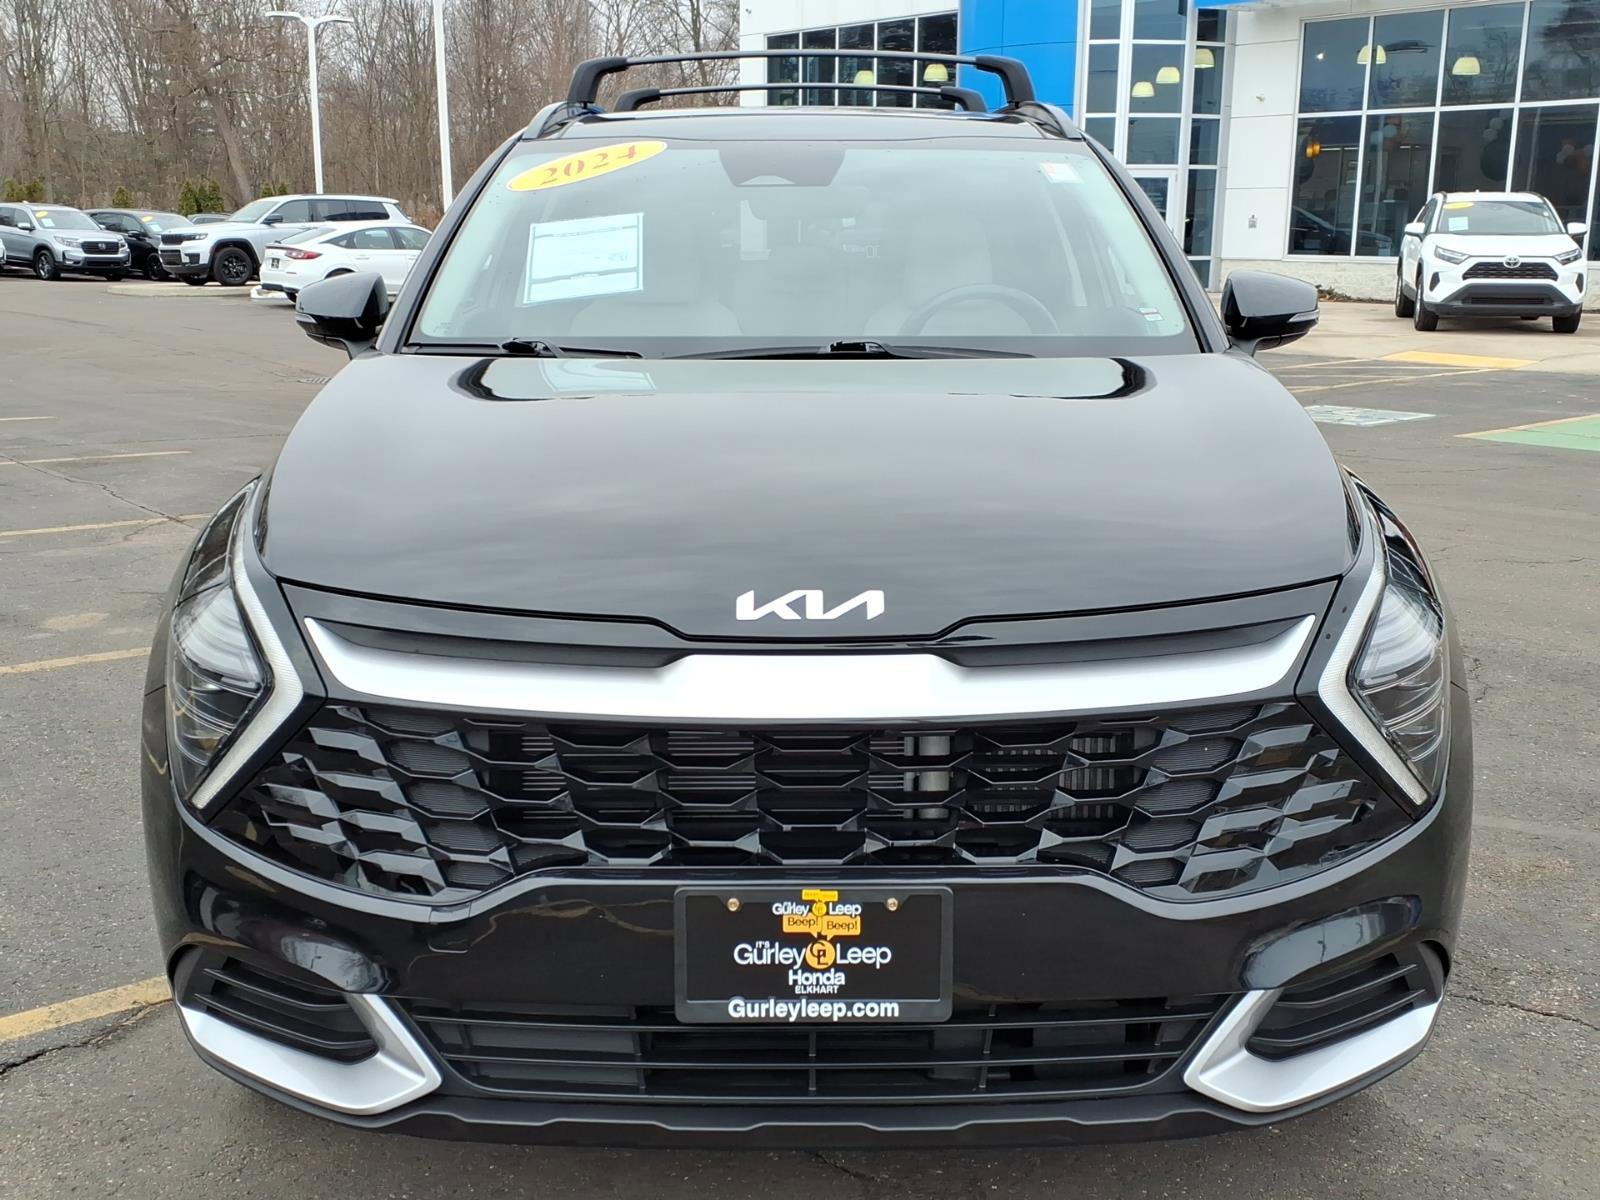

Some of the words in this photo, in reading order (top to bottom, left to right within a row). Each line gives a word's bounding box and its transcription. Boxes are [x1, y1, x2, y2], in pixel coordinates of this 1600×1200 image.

[539, 144, 637, 186] 2024
[829, 902, 862, 918] Leep
[787, 917, 819, 928] Beep!
[827, 921, 858, 932] Beep!
[733, 942, 807, 969] Gurley
[836, 942, 892, 969] Leep
[788, 968, 846, 985] Honda
[795, 985, 839, 994] ELKHART
[728, 999, 900, 1022] Gurleyleep.com
